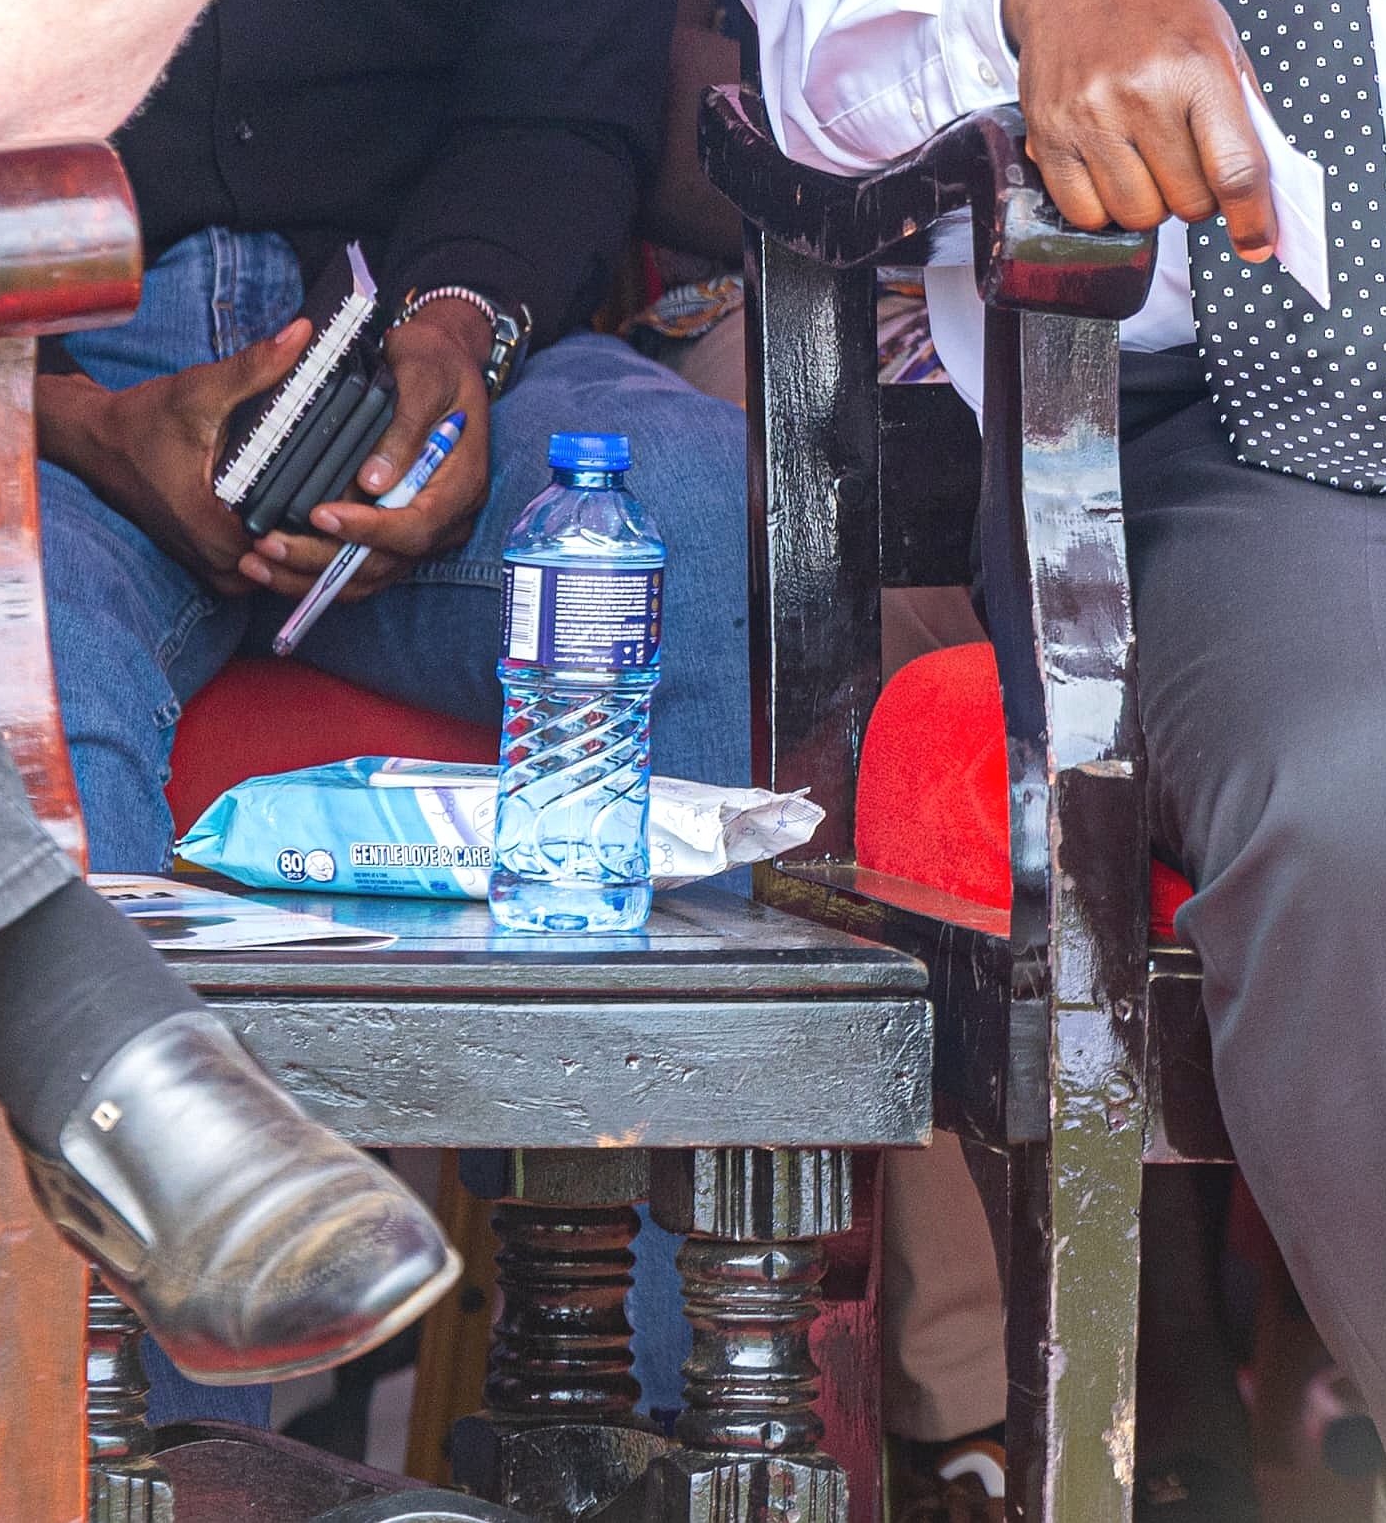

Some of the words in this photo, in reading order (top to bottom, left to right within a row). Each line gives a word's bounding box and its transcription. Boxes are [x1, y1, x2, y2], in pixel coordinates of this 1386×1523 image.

[280, 853, 304, 872] 80
[352, 845, 402, 867] GENTLE
[403, 846, 439, 867] LOVE
[440, 847, 452, 867] &
[453, 846, 492, 867] CARE
